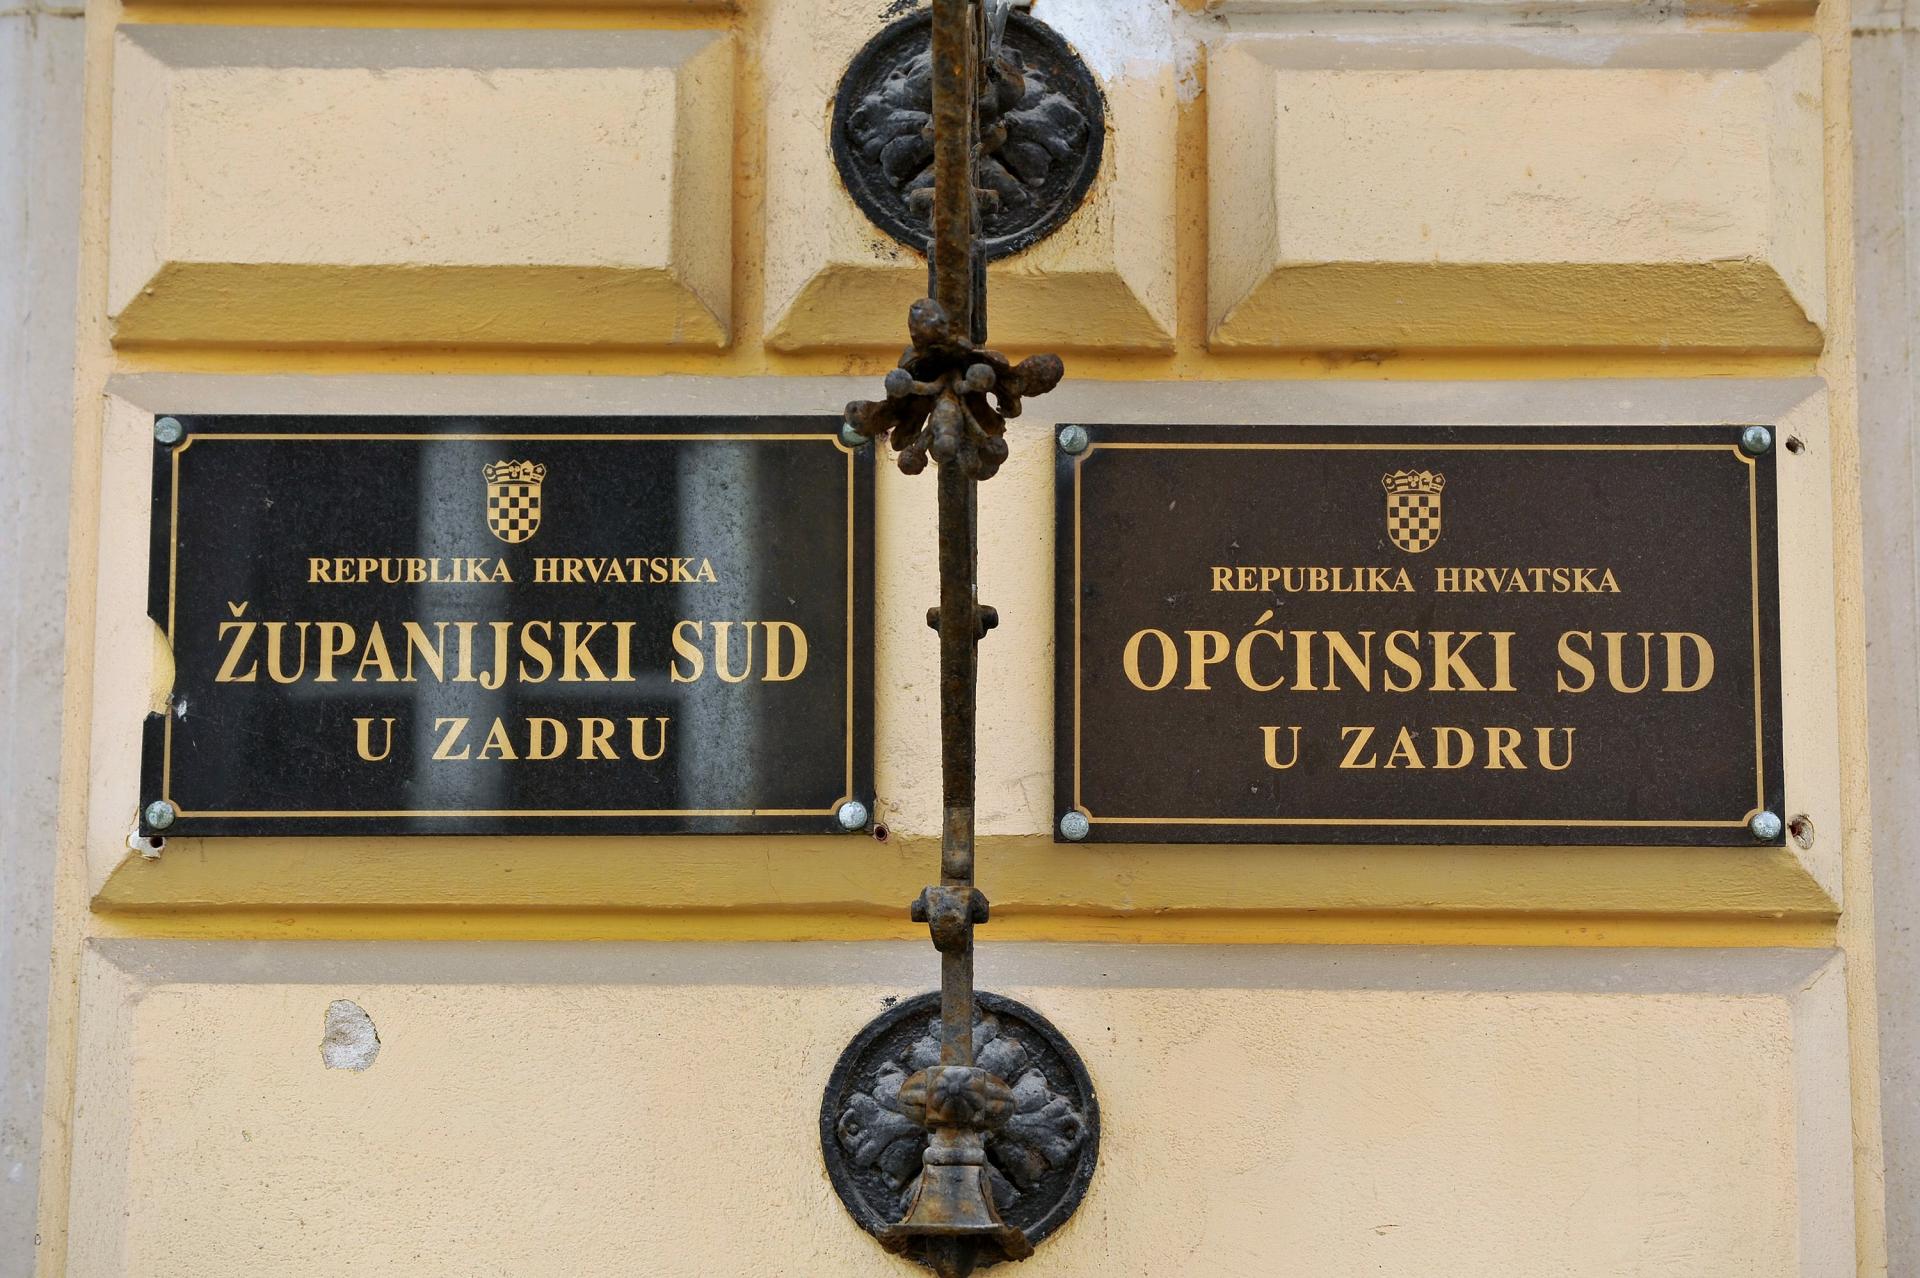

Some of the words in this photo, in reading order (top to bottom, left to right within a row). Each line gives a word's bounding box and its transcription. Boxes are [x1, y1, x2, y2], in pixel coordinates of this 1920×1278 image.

[308, 557, 513, 584] REPUBLIKA
[533, 557, 718, 584] HRVATSKA
[1211, 566, 1416, 593] REPUBLIKA
[1434, 566, 1622, 593] HRVATSKA
[215, 601, 637, 690] ŽUPANIJSKI
[670, 619, 808, 684] SUD
[1122, 609, 1518, 693] OPĆINSKI
[1556, 630, 1716, 694] SUD
[353, 717, 395, 762] U
[433, 716, 670, 762] ZADRU
[1259, 725, 1304, 770] U
[1339, 725, 1577, 771] ZADRU
